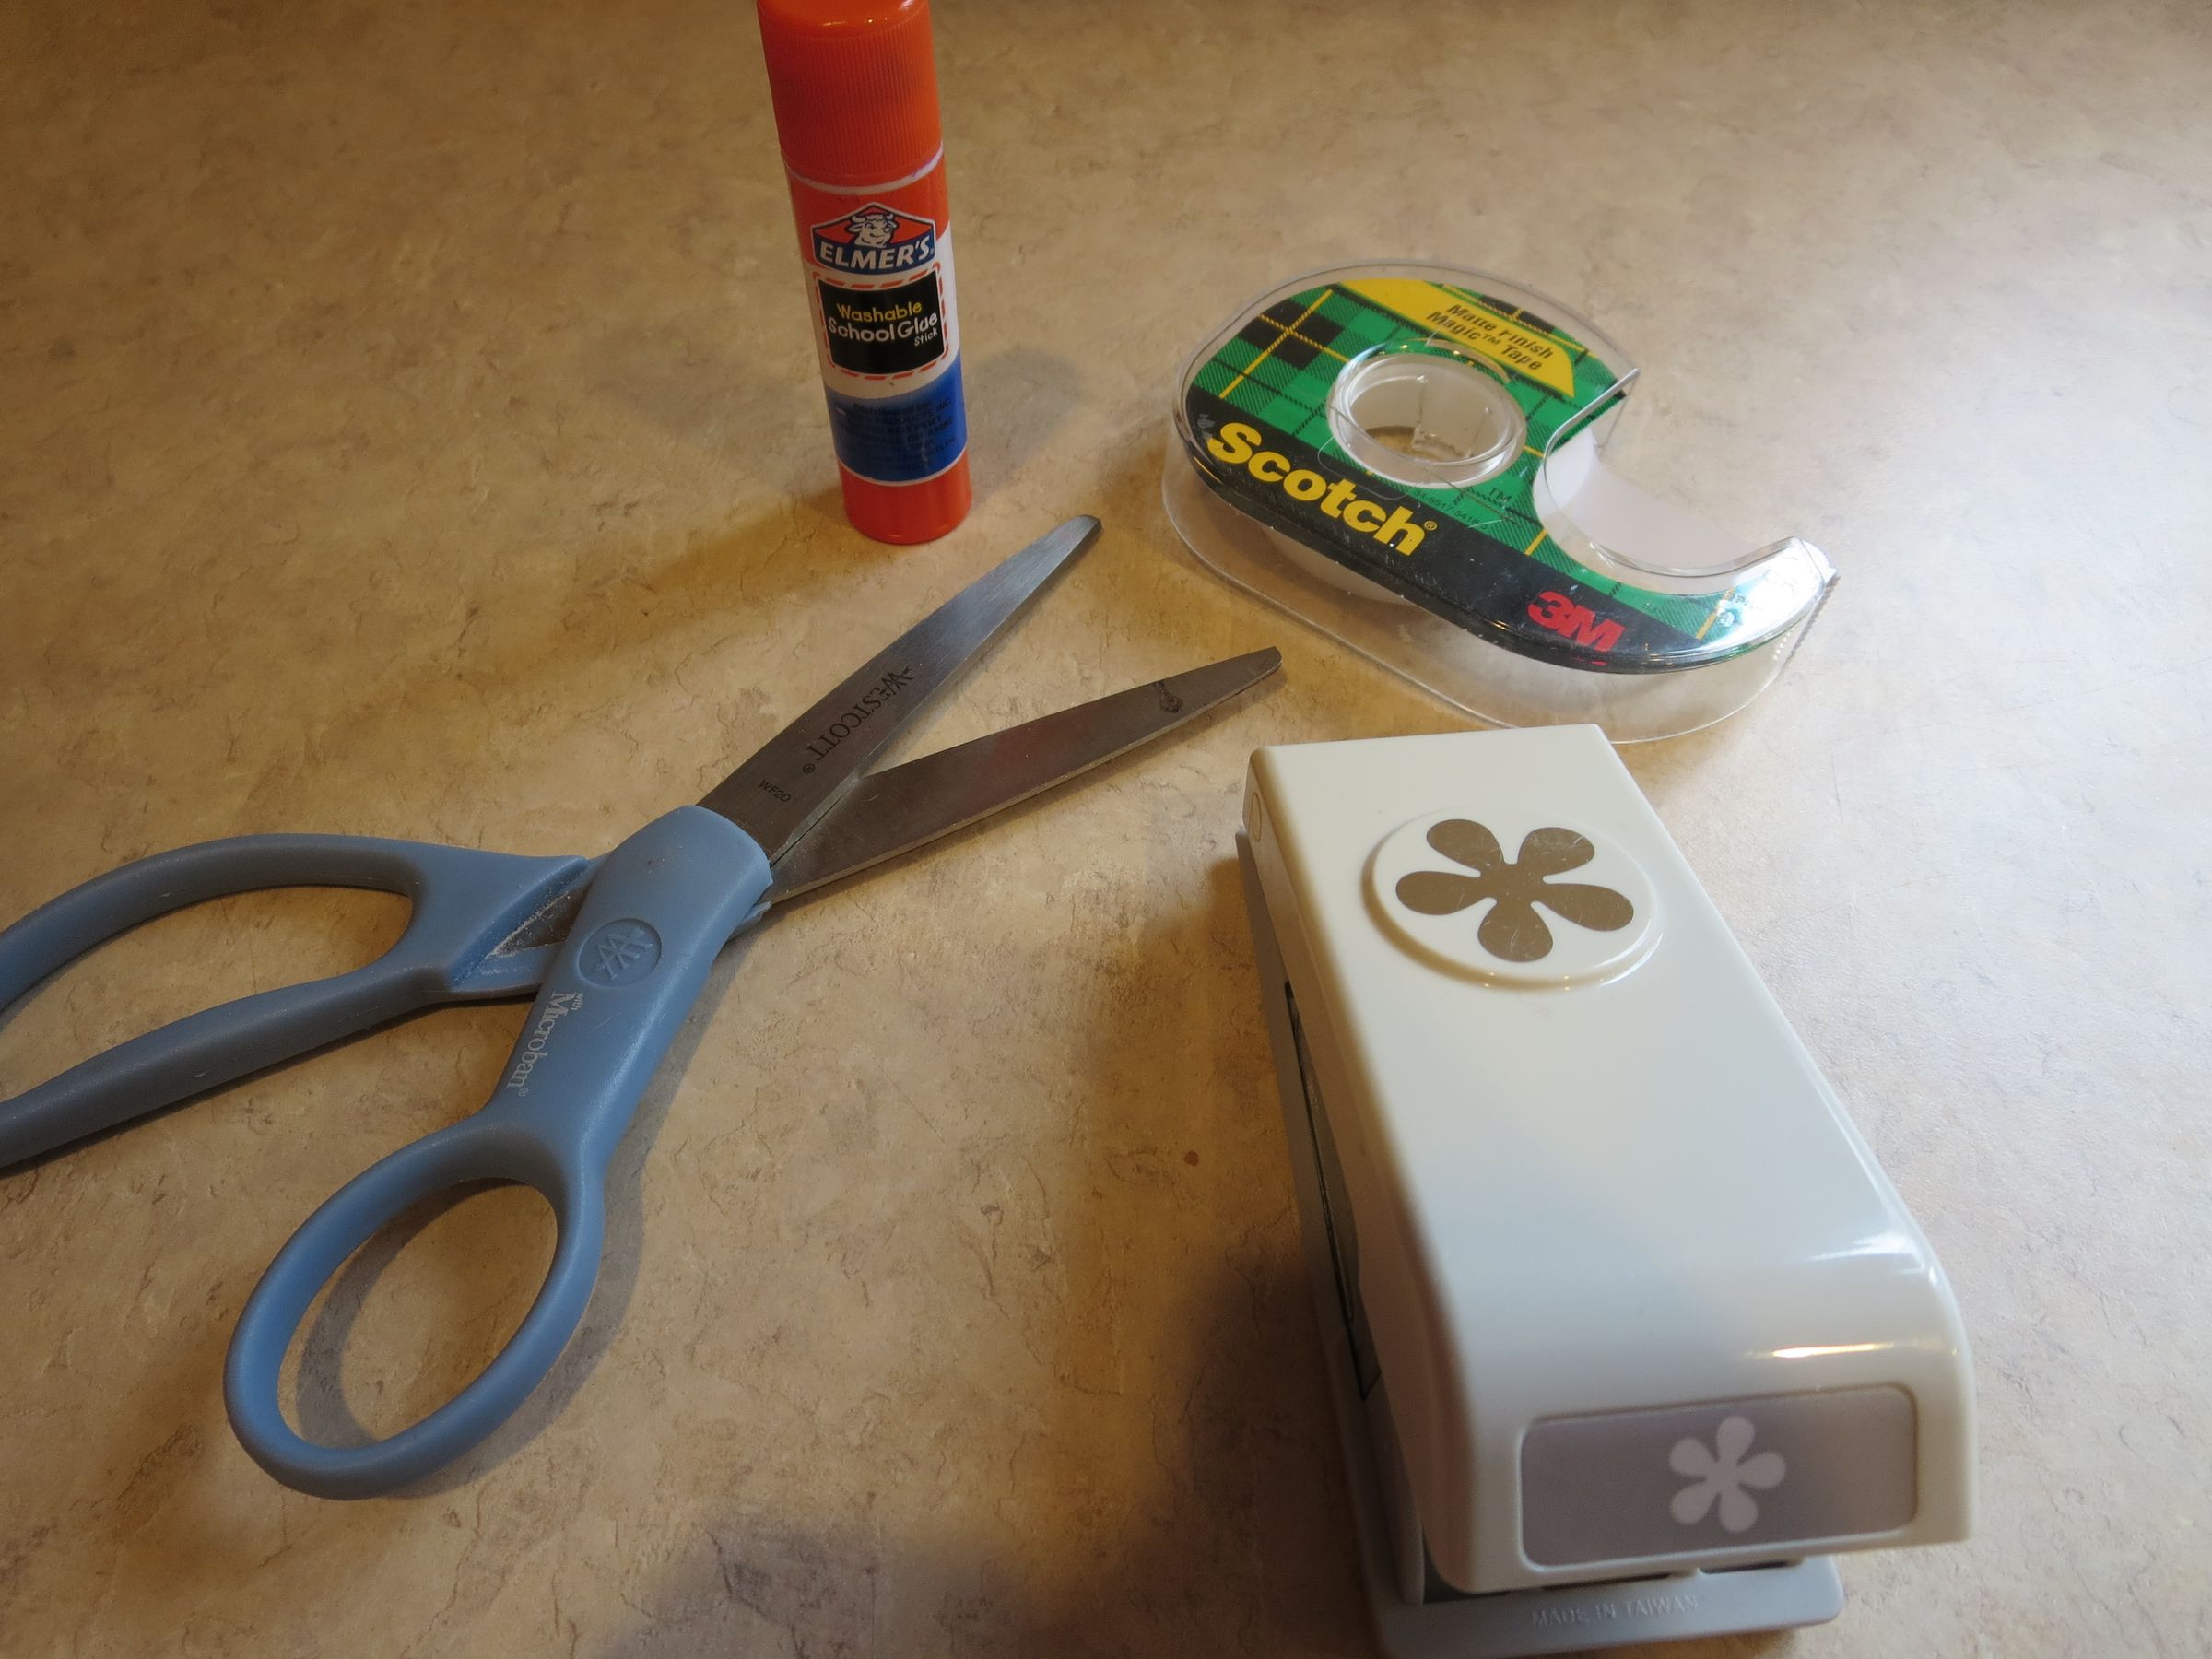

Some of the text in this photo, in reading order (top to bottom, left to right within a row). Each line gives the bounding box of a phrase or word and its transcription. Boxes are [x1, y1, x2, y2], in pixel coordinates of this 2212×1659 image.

[819, 236, 930, 270] ELMER'S
[829, 312, 938, 343] School Glue
[836, 301, 923, 323] Washable
[914, 327, 938, 347] Stick
[1501, 344, 1544, 371] Tape
[1206, 421, 1427, 557] Scotch
[1525, 590, 1627, 653] 3M
[806, 665, 914, 762] WESTCOTT
[571, 991, 585, 1011] with
[506, 990, 577, 1089] Microban
[1533, 1594, 1700, 1628] MADE IN TAIWAN
